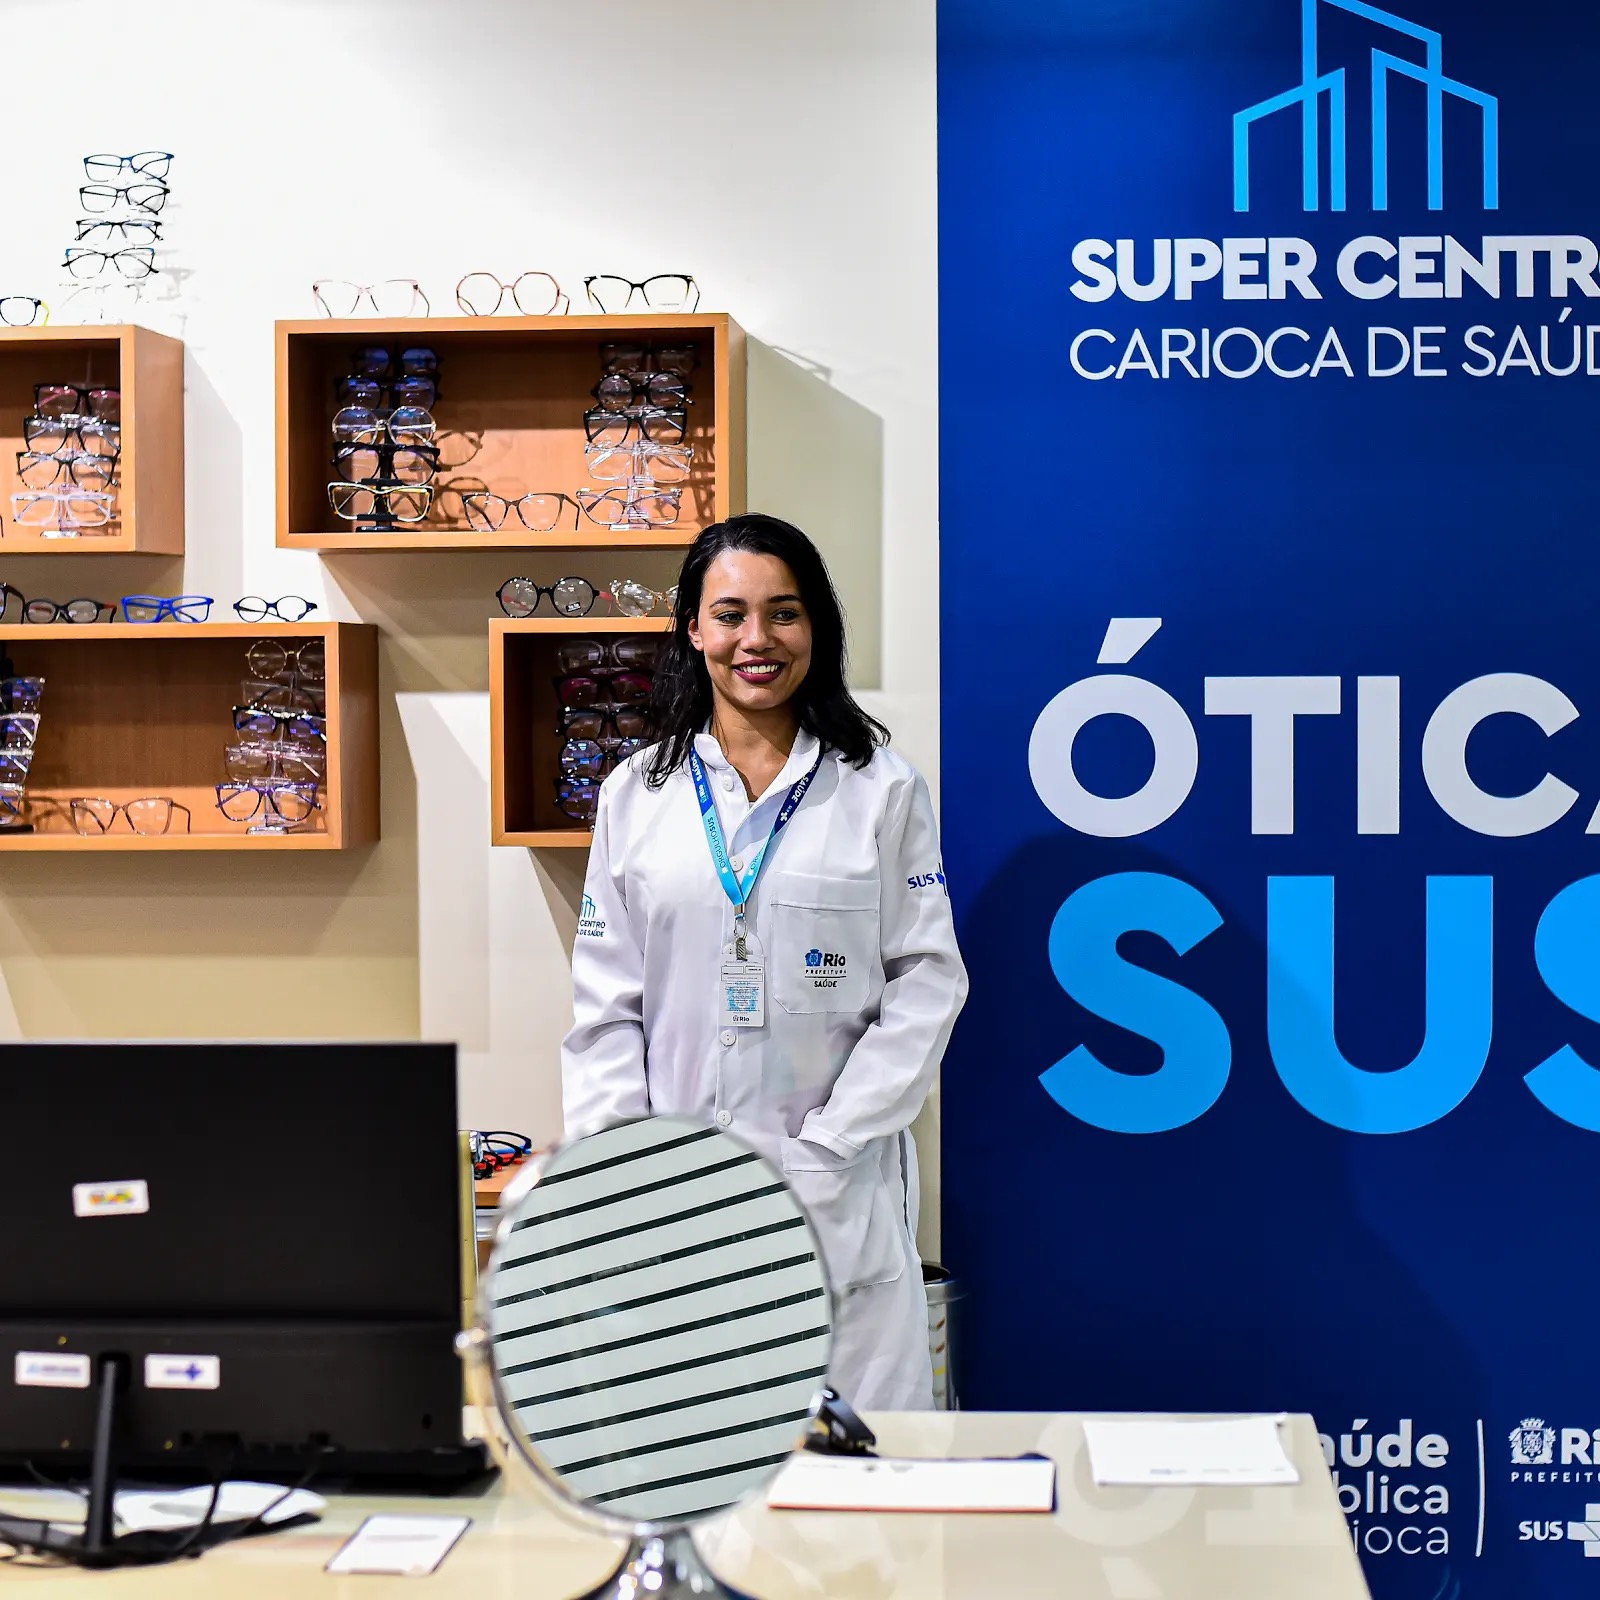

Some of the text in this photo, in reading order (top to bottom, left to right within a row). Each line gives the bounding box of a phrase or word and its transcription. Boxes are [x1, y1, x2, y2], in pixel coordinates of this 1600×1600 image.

[1069, 235, 1600, 302] SUPER CENTR
[1069, 307, 1600, 380] CARIOCA DE SAÚ
[1028, 617, 1600, 838] ÓTIC
[791, 775, 809, 803] SAÚDE
[907, 873, 935, 890] SUS
[580, 919, 605, 929] CENTRO
[587, 928, 604, 938] SAÚDE
[823, 952, 846, 967] Rio
[813, 978, 838, 988] SAÚDE
[1510, 1471, 1600, 1483] PREFEIT
[1347, 1519, 1449, 1555] ioca
[1518, 1520, 1564, 1541] SUS
